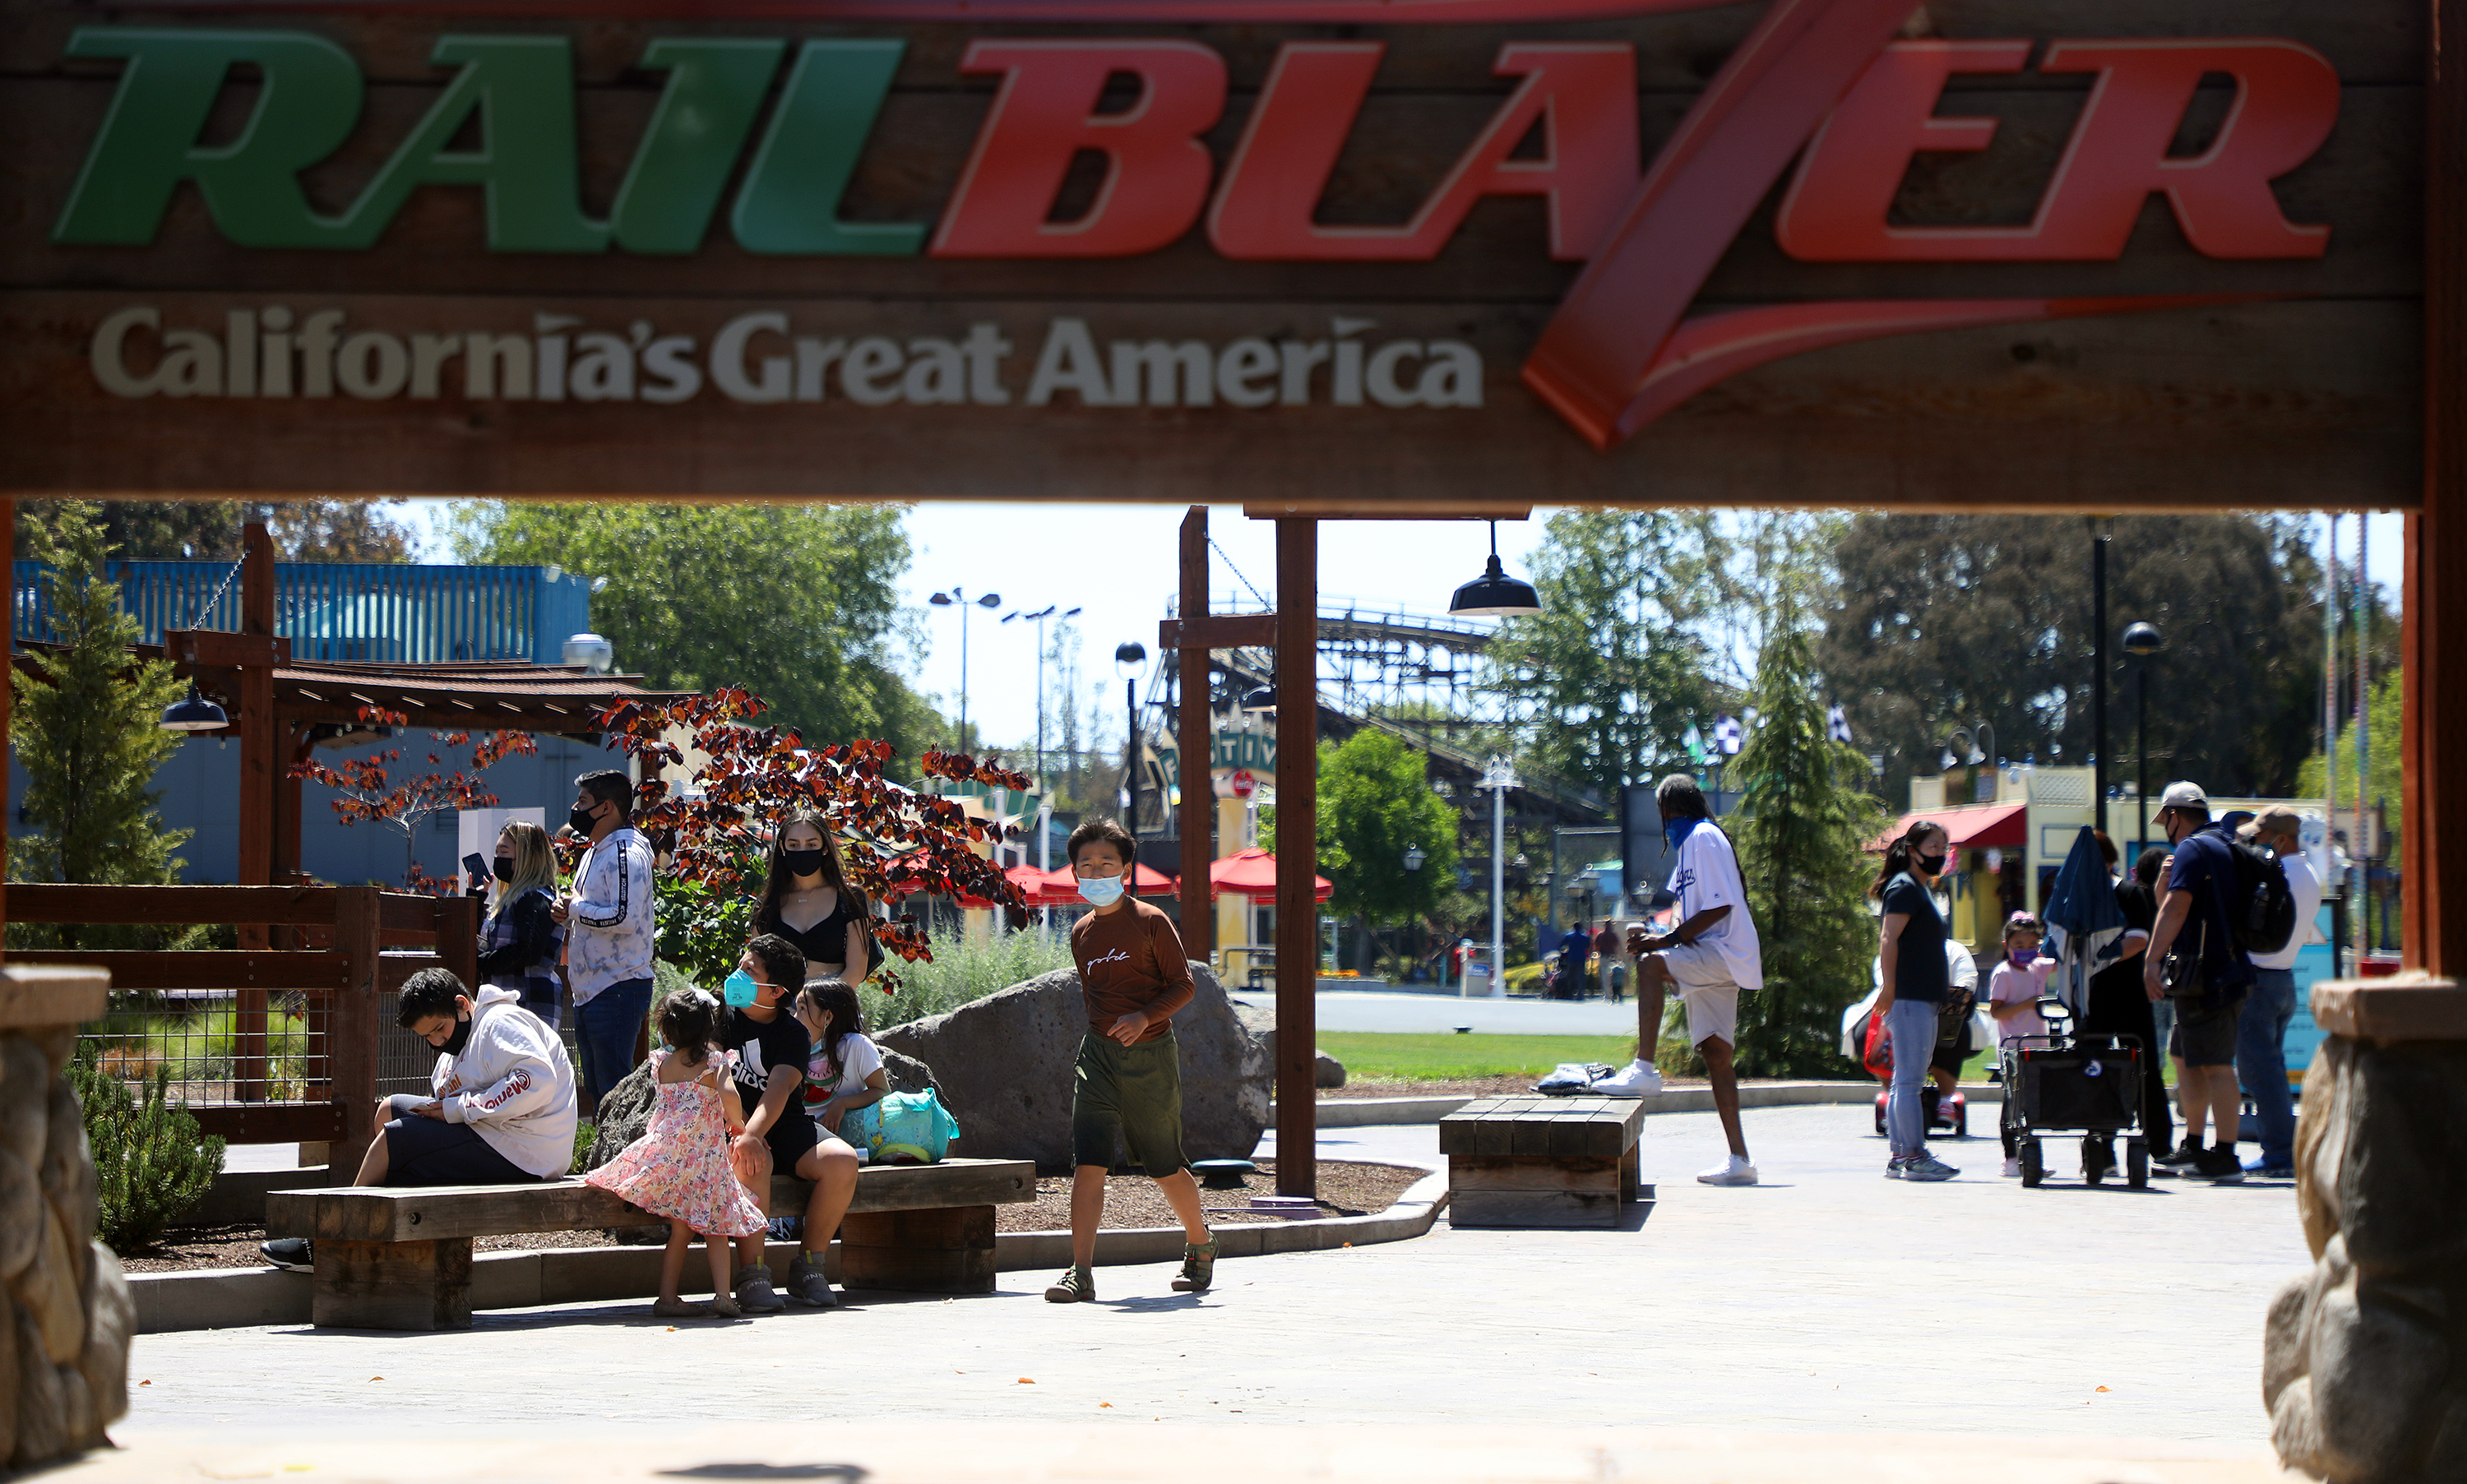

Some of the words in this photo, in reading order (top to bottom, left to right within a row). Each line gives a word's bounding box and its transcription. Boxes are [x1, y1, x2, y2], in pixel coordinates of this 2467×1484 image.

[90, 305, 701, 402] California's
[709, 312, 1009, 404] Great
[1026, 318, 1484, 409] America
[730, 1062, 768, 1092] dida
